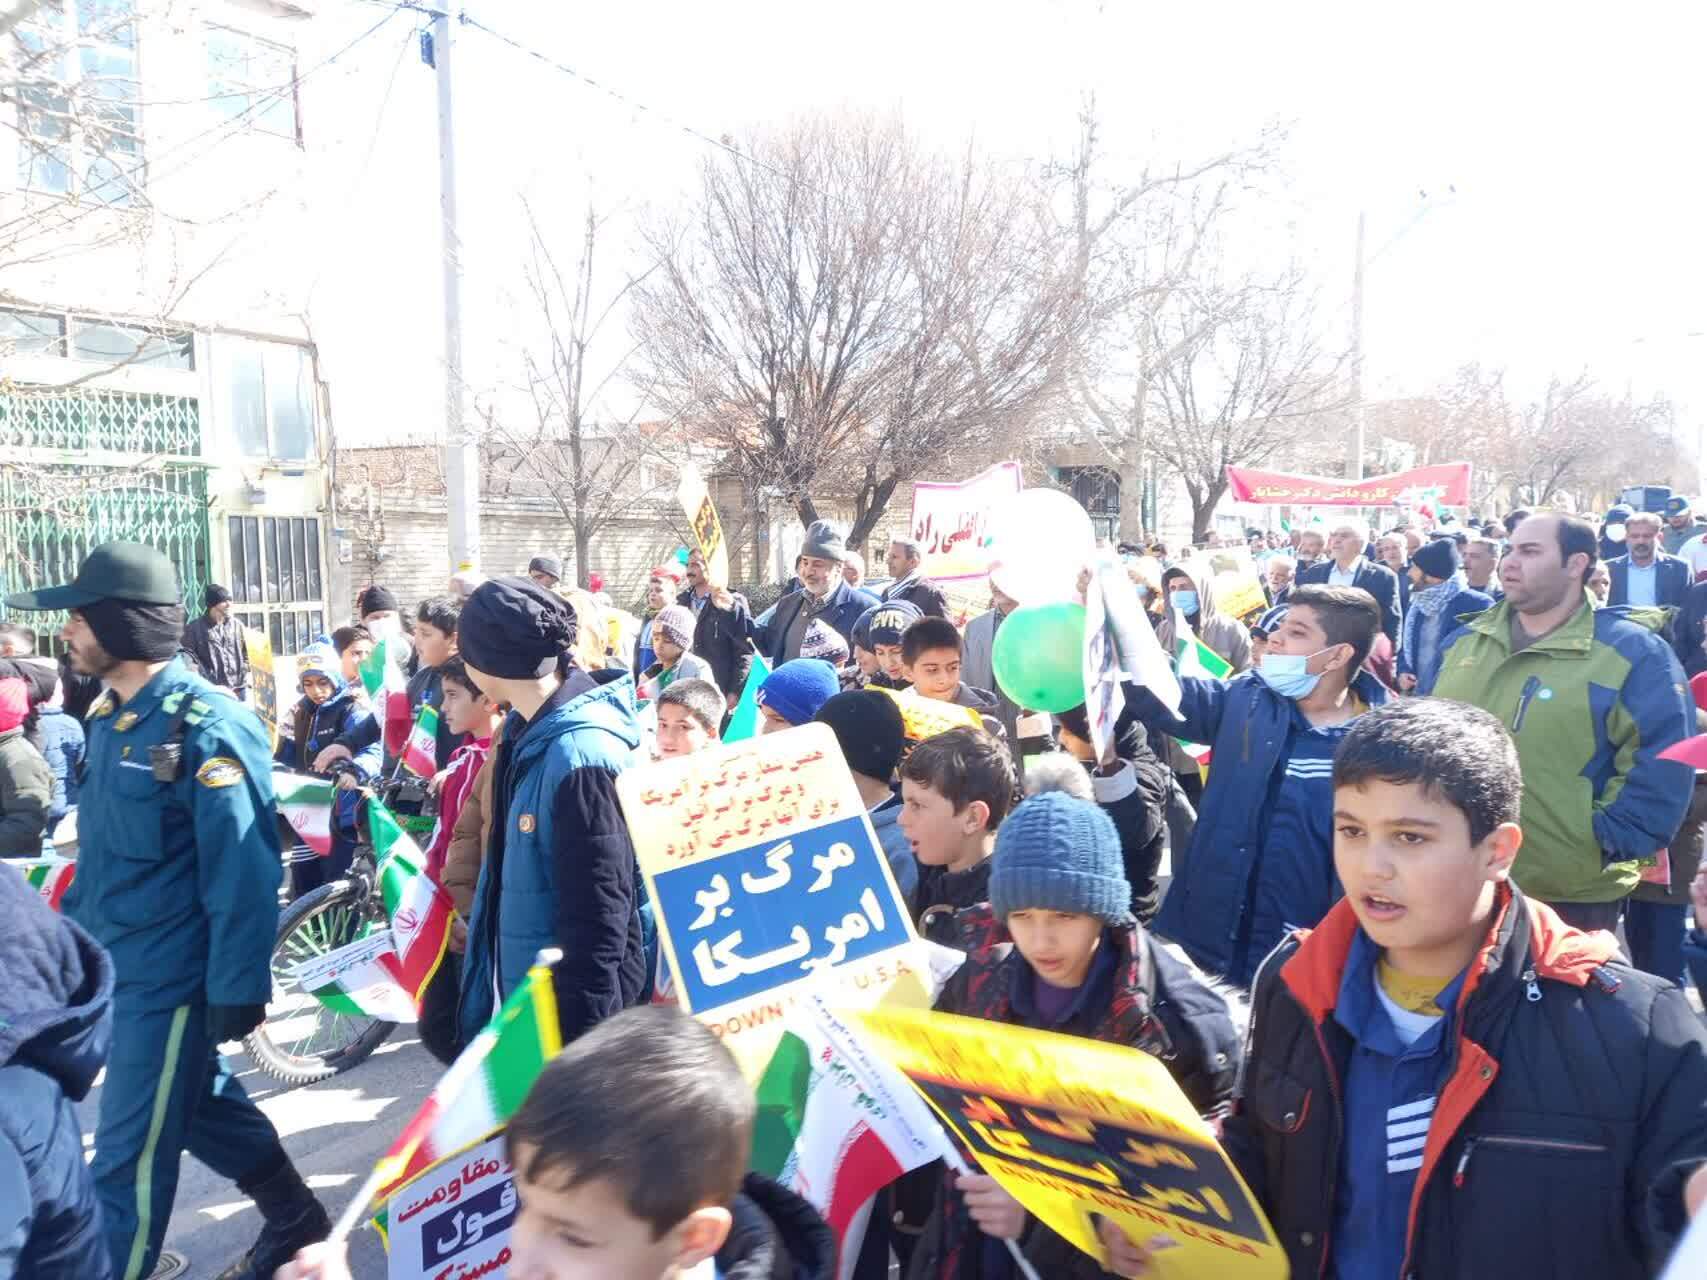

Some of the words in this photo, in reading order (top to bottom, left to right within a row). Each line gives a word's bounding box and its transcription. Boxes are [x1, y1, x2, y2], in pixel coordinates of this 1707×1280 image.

[740, 840, 856, 893] مرگ
[688, 873, 731, 931] بر
[692, 887, 886, 987] امریکا
[708, 1003, 783, 1038] DOWN
[960, 1094, 1016, 1130] بر
[1021, 1100, 1197, 1172] مرگ
[398, 1157, 500, 1223] مقاومت
[968, 1119, 1233, 1223] امریکا
